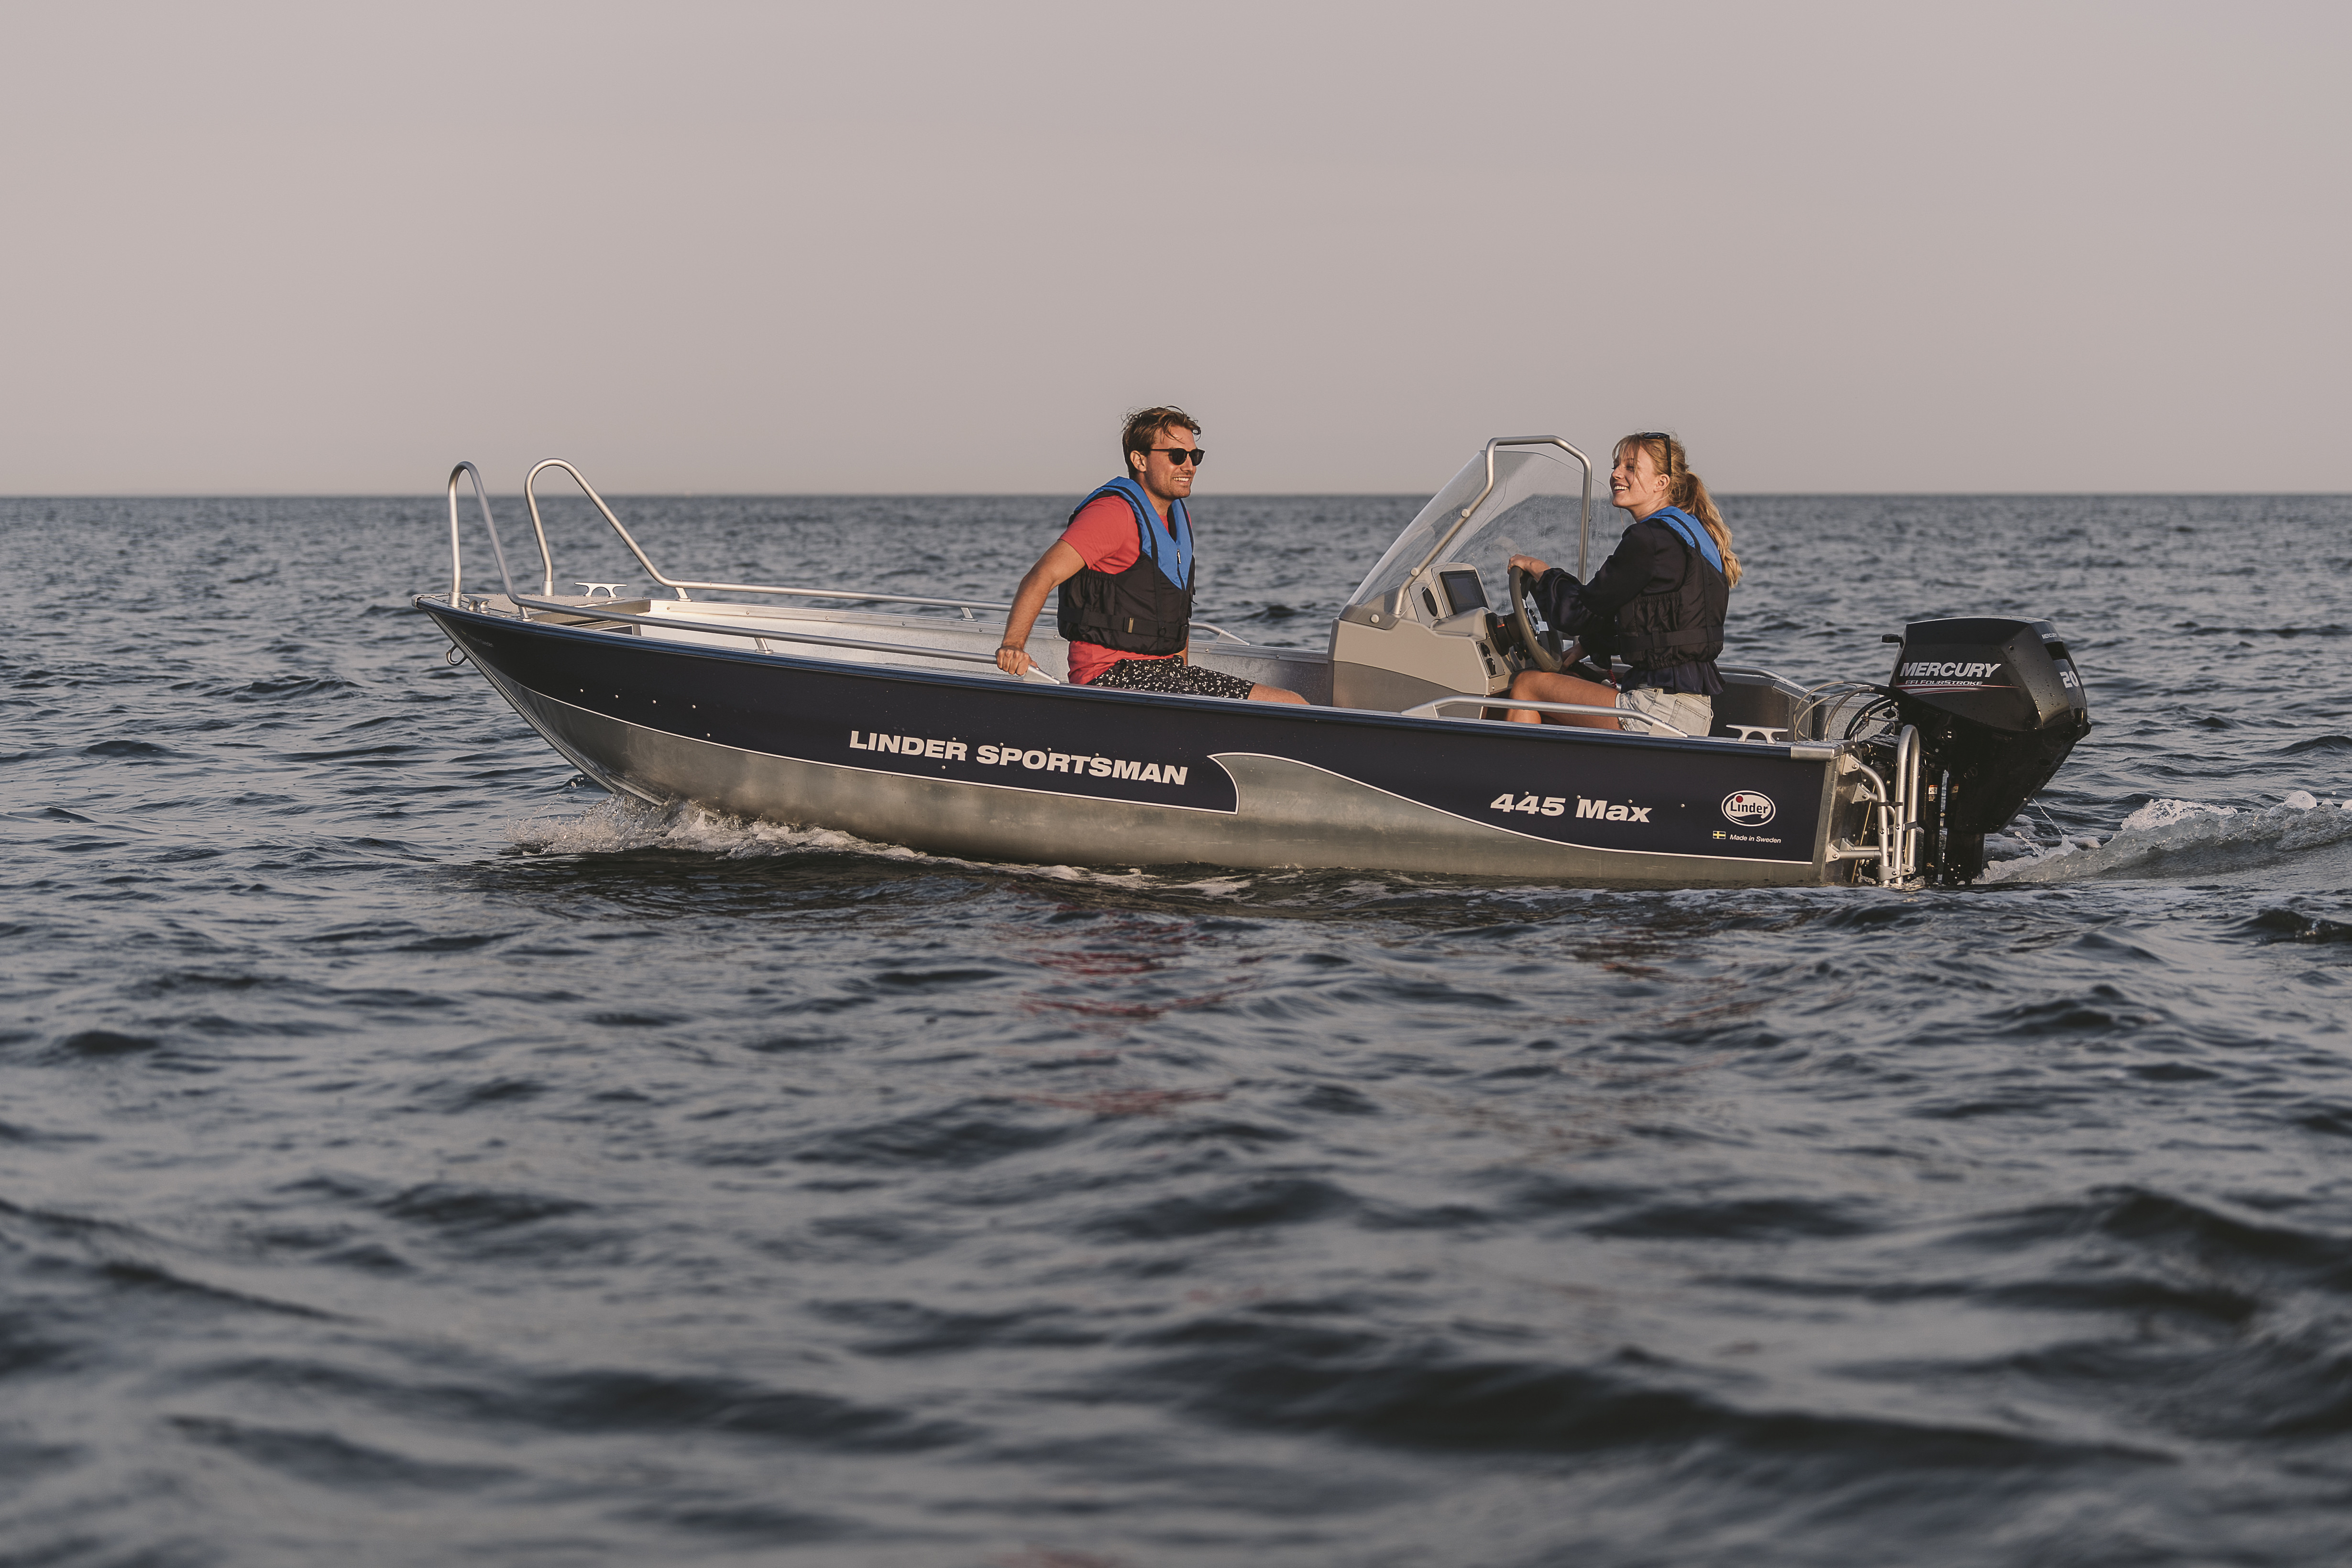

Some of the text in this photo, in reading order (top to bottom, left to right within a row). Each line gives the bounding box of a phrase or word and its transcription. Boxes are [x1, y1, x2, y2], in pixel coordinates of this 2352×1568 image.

[1900, 662, 2001, 677] MERCURY
[2059, 670, 2079, 688] 20
[849, 730, 1188, 785] LINDER SPORTSMAN
[1490, 793, 1652, 823] 445 Max
[1730, 800, 1769, 813] Linder
